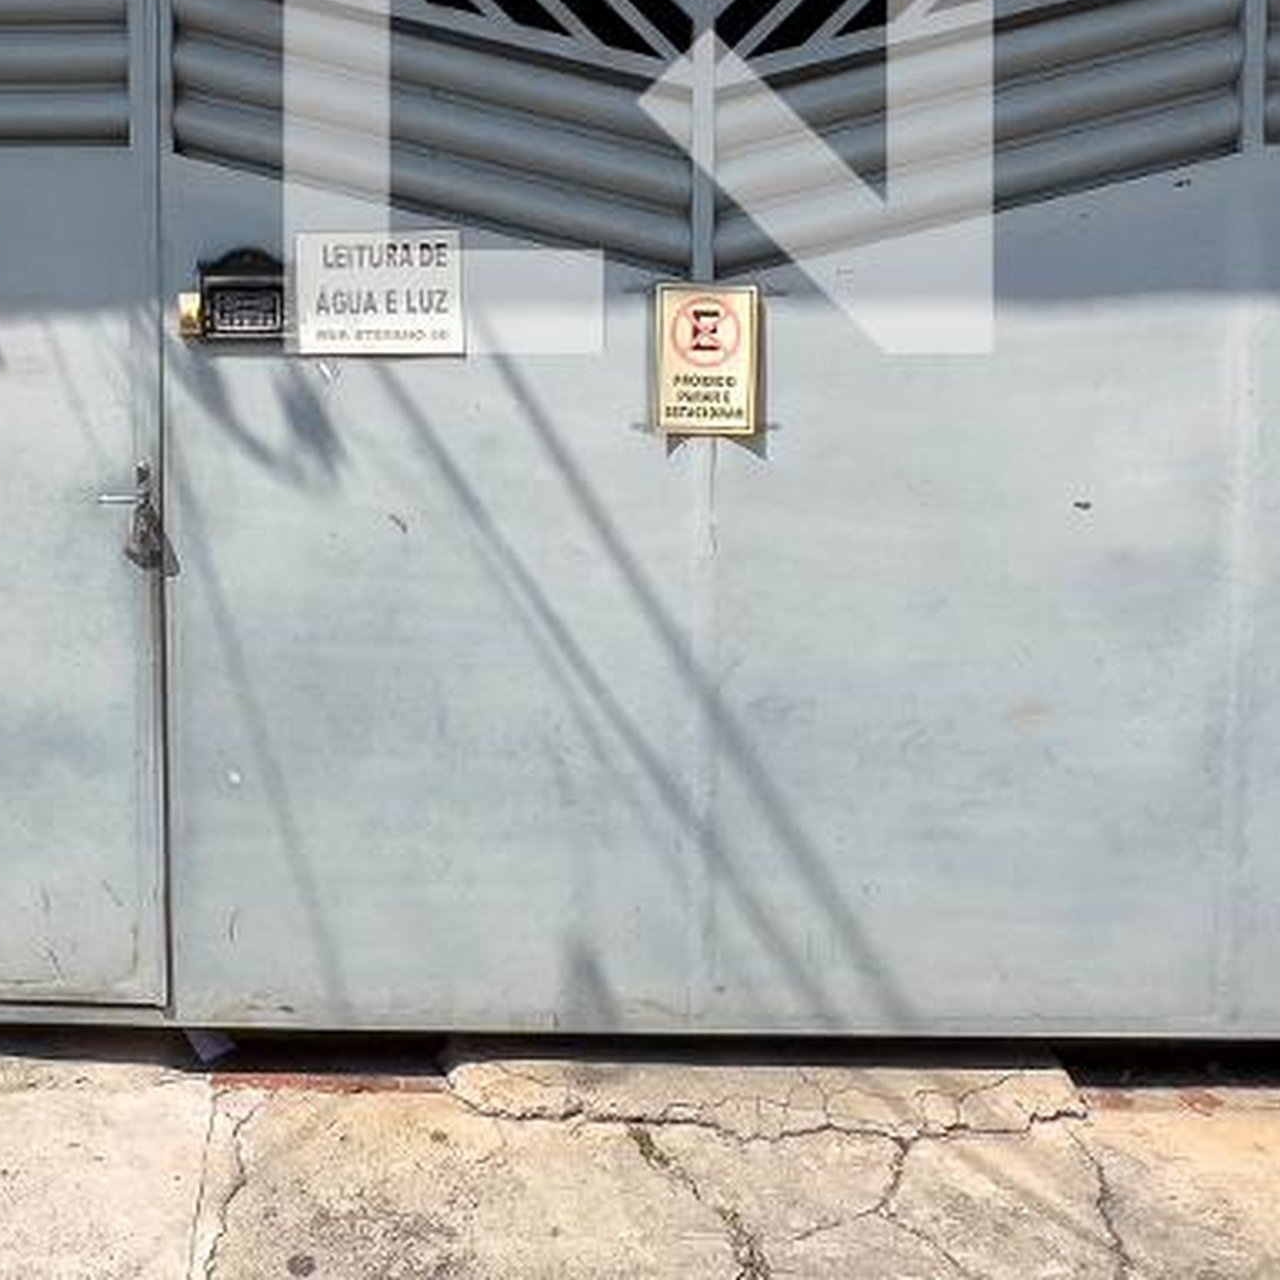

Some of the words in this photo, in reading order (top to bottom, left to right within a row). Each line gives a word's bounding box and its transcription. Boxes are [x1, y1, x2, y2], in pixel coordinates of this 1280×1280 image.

[322, 243, 414, 268] LEITURA
[419, 242, 448, 268] DE
[385, 289, 397, 314] E
[405, 289, 449, 314] LUZ
